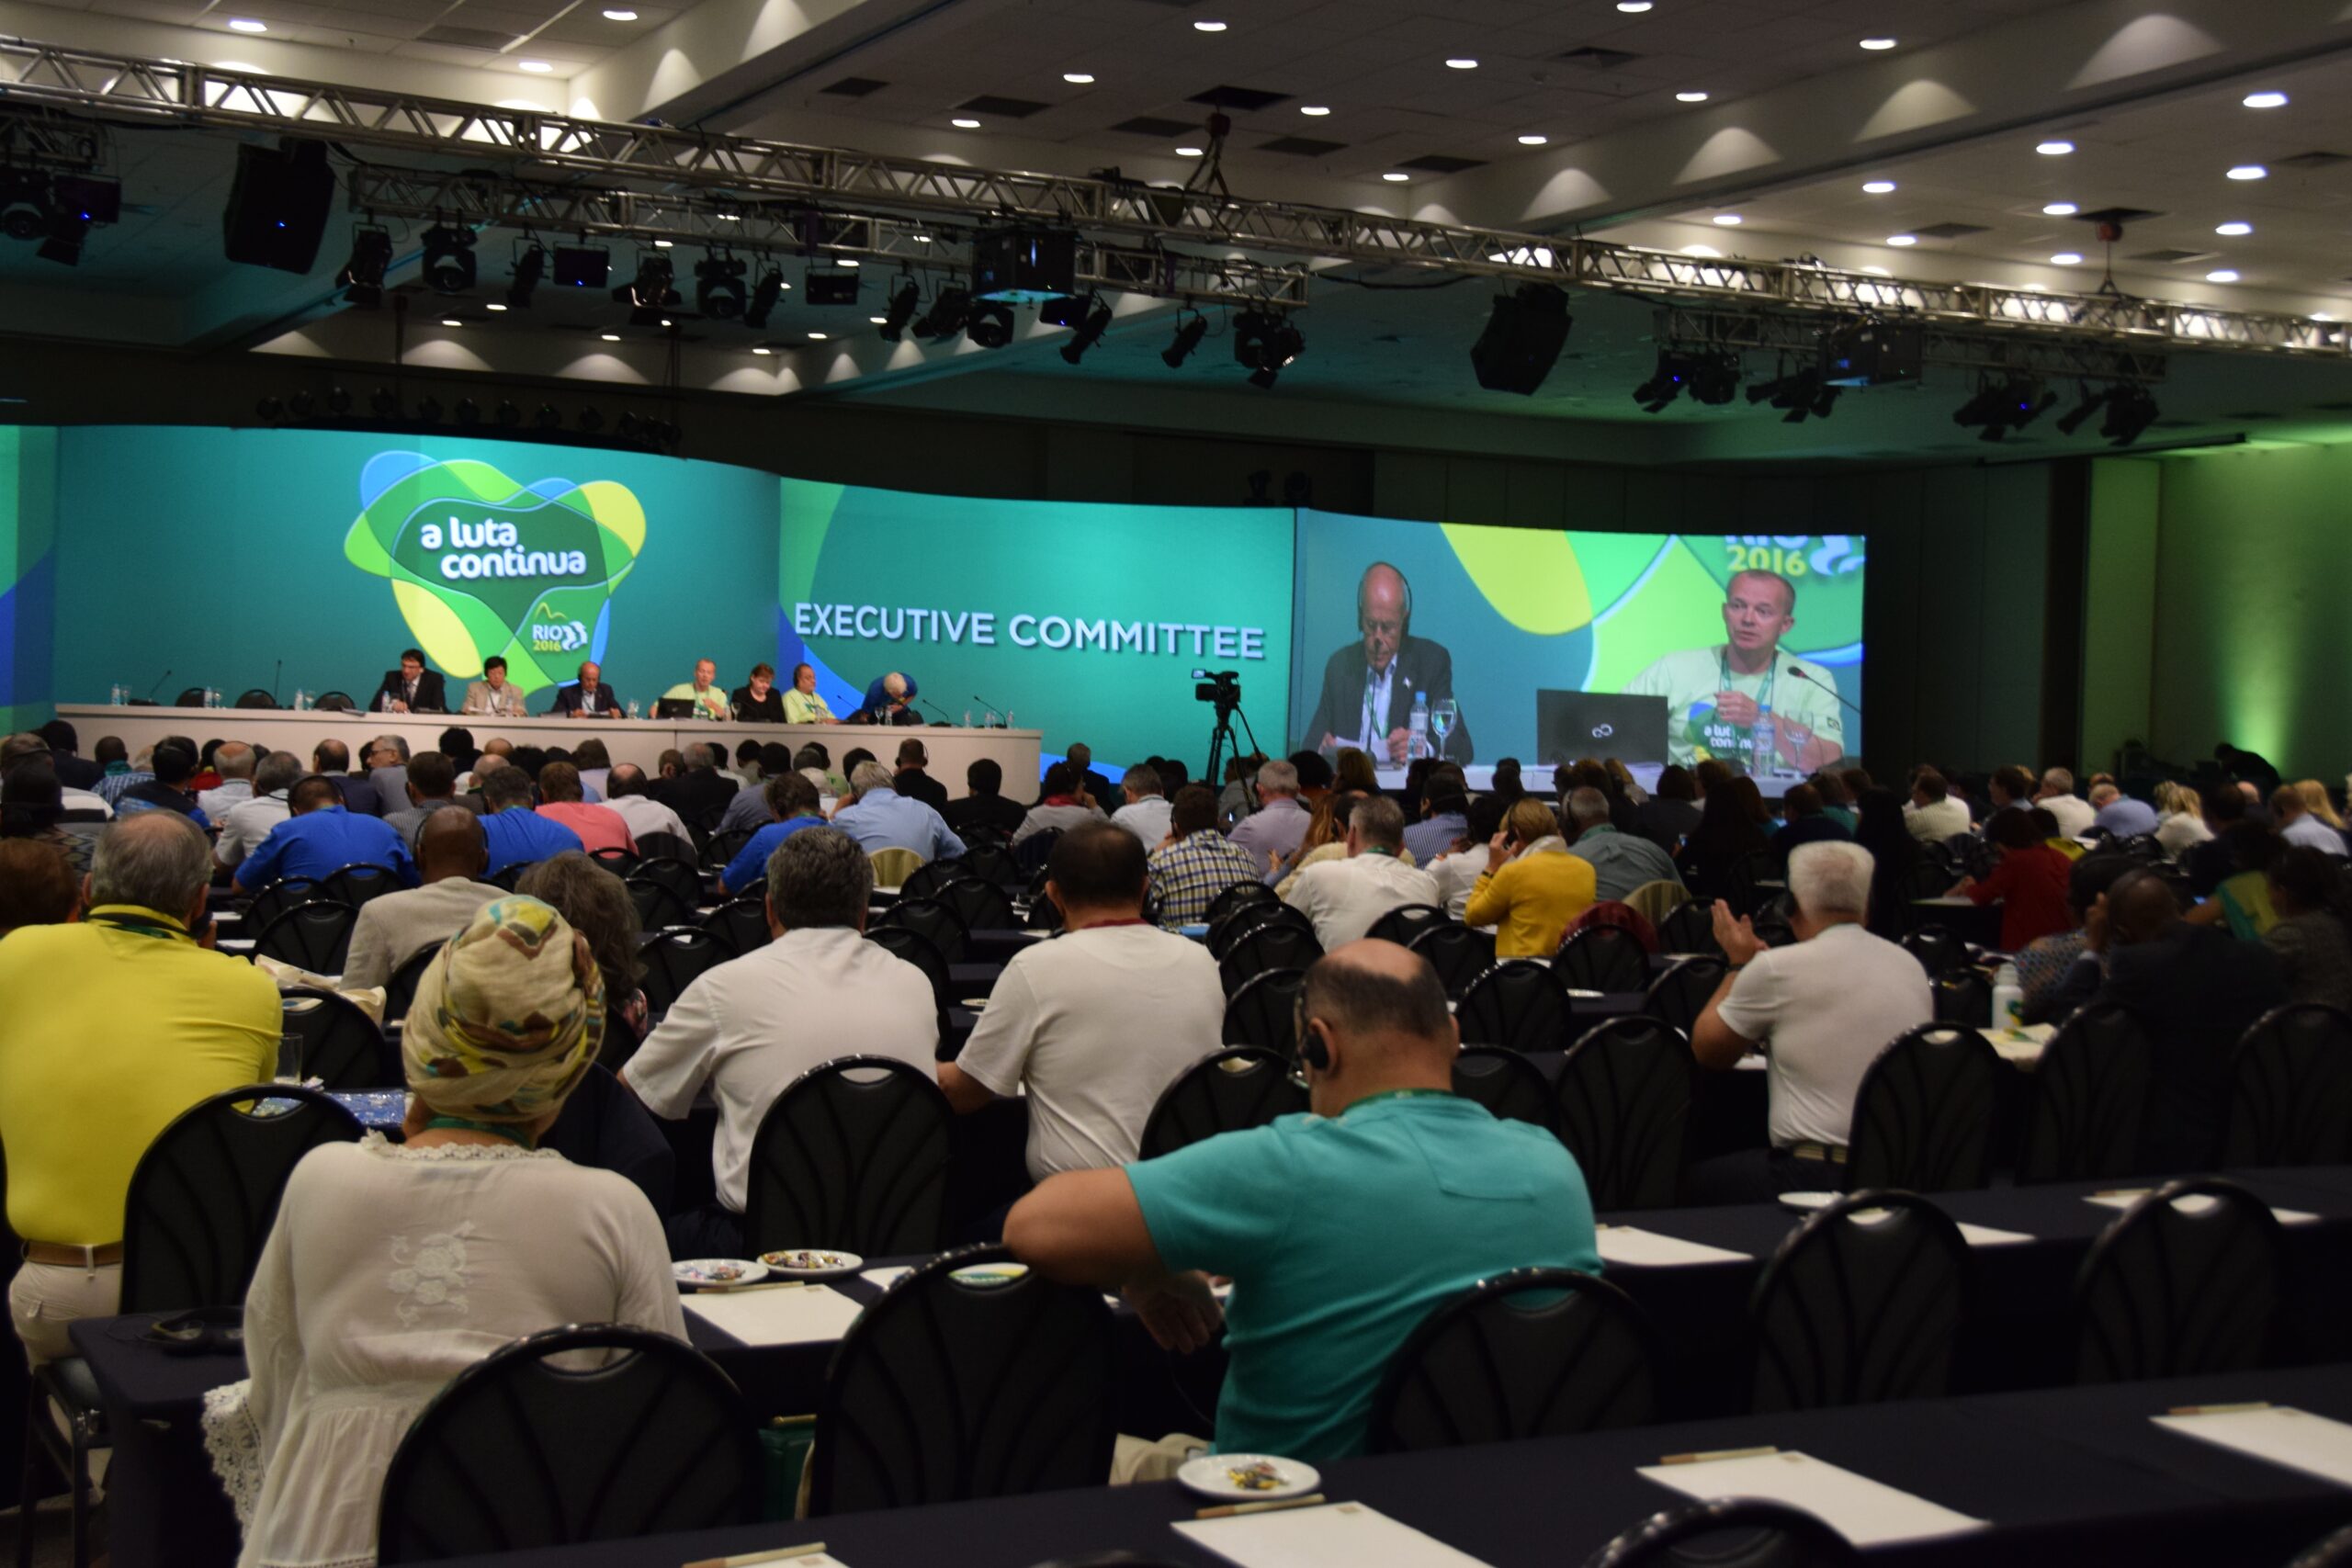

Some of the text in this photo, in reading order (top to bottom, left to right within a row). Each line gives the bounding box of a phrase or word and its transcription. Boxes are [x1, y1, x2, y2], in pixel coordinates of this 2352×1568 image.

[421, 516, 517, 549] a luta
[441, 544, 586, 580] continua
[1726, 545, 1806, 576] 2016
[533, 625, 562, 641] RIO
[533, 639, 561, 652] 2016
[795, 602, 1265, 660] EXECUTIVE COMMITTEE
